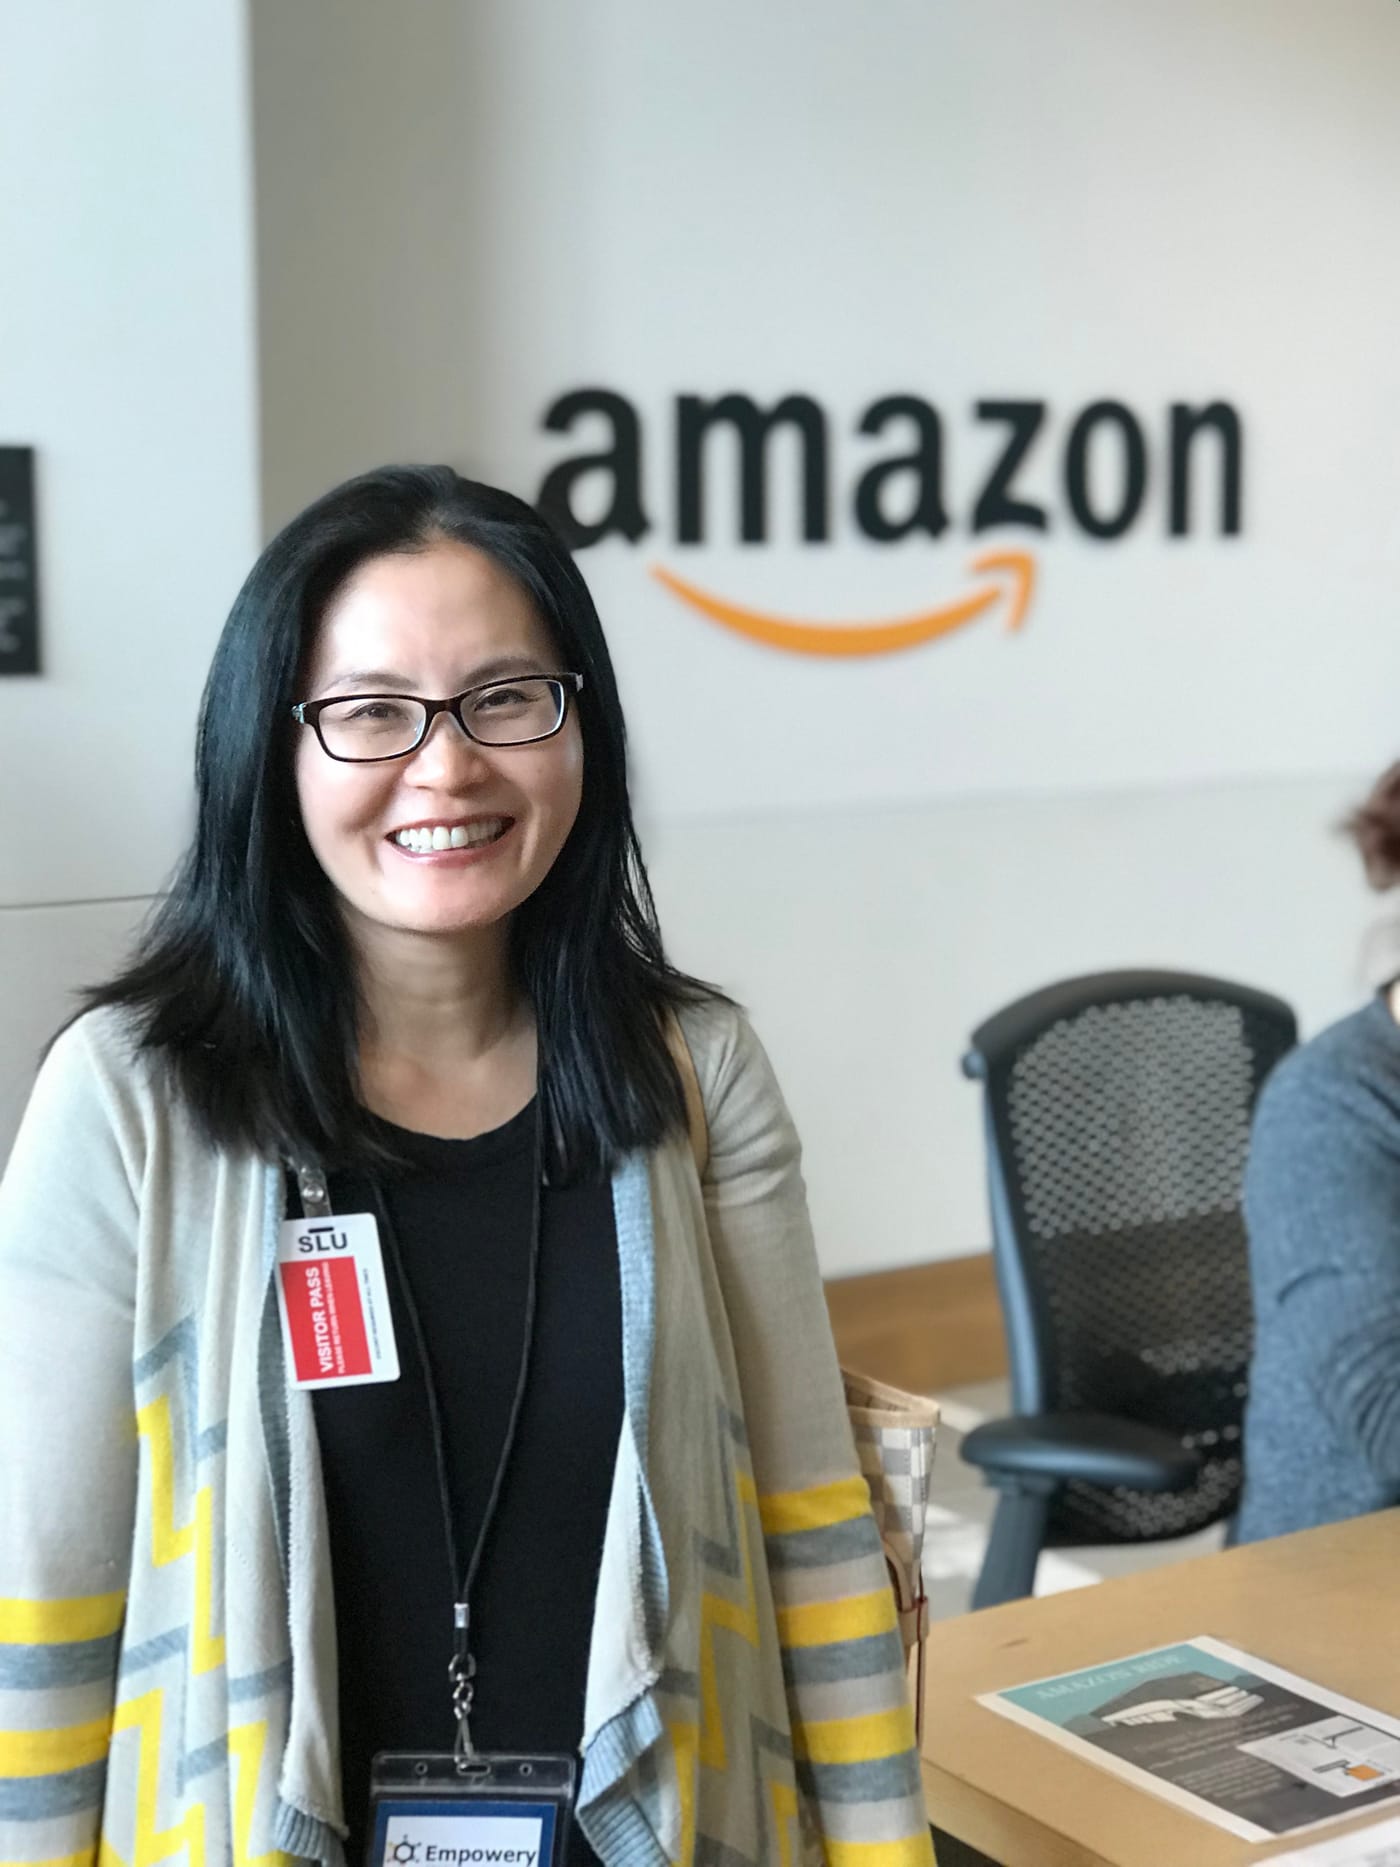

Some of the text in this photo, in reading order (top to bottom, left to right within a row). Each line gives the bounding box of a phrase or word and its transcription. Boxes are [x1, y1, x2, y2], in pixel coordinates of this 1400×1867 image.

[537, 388, 1243, 550] amazon
[298, 1232, 348, 1253] SLU
[305, 1266, 334, 1373] VISITOR PASS
[426, 1844, 536, 1865] Empowery
